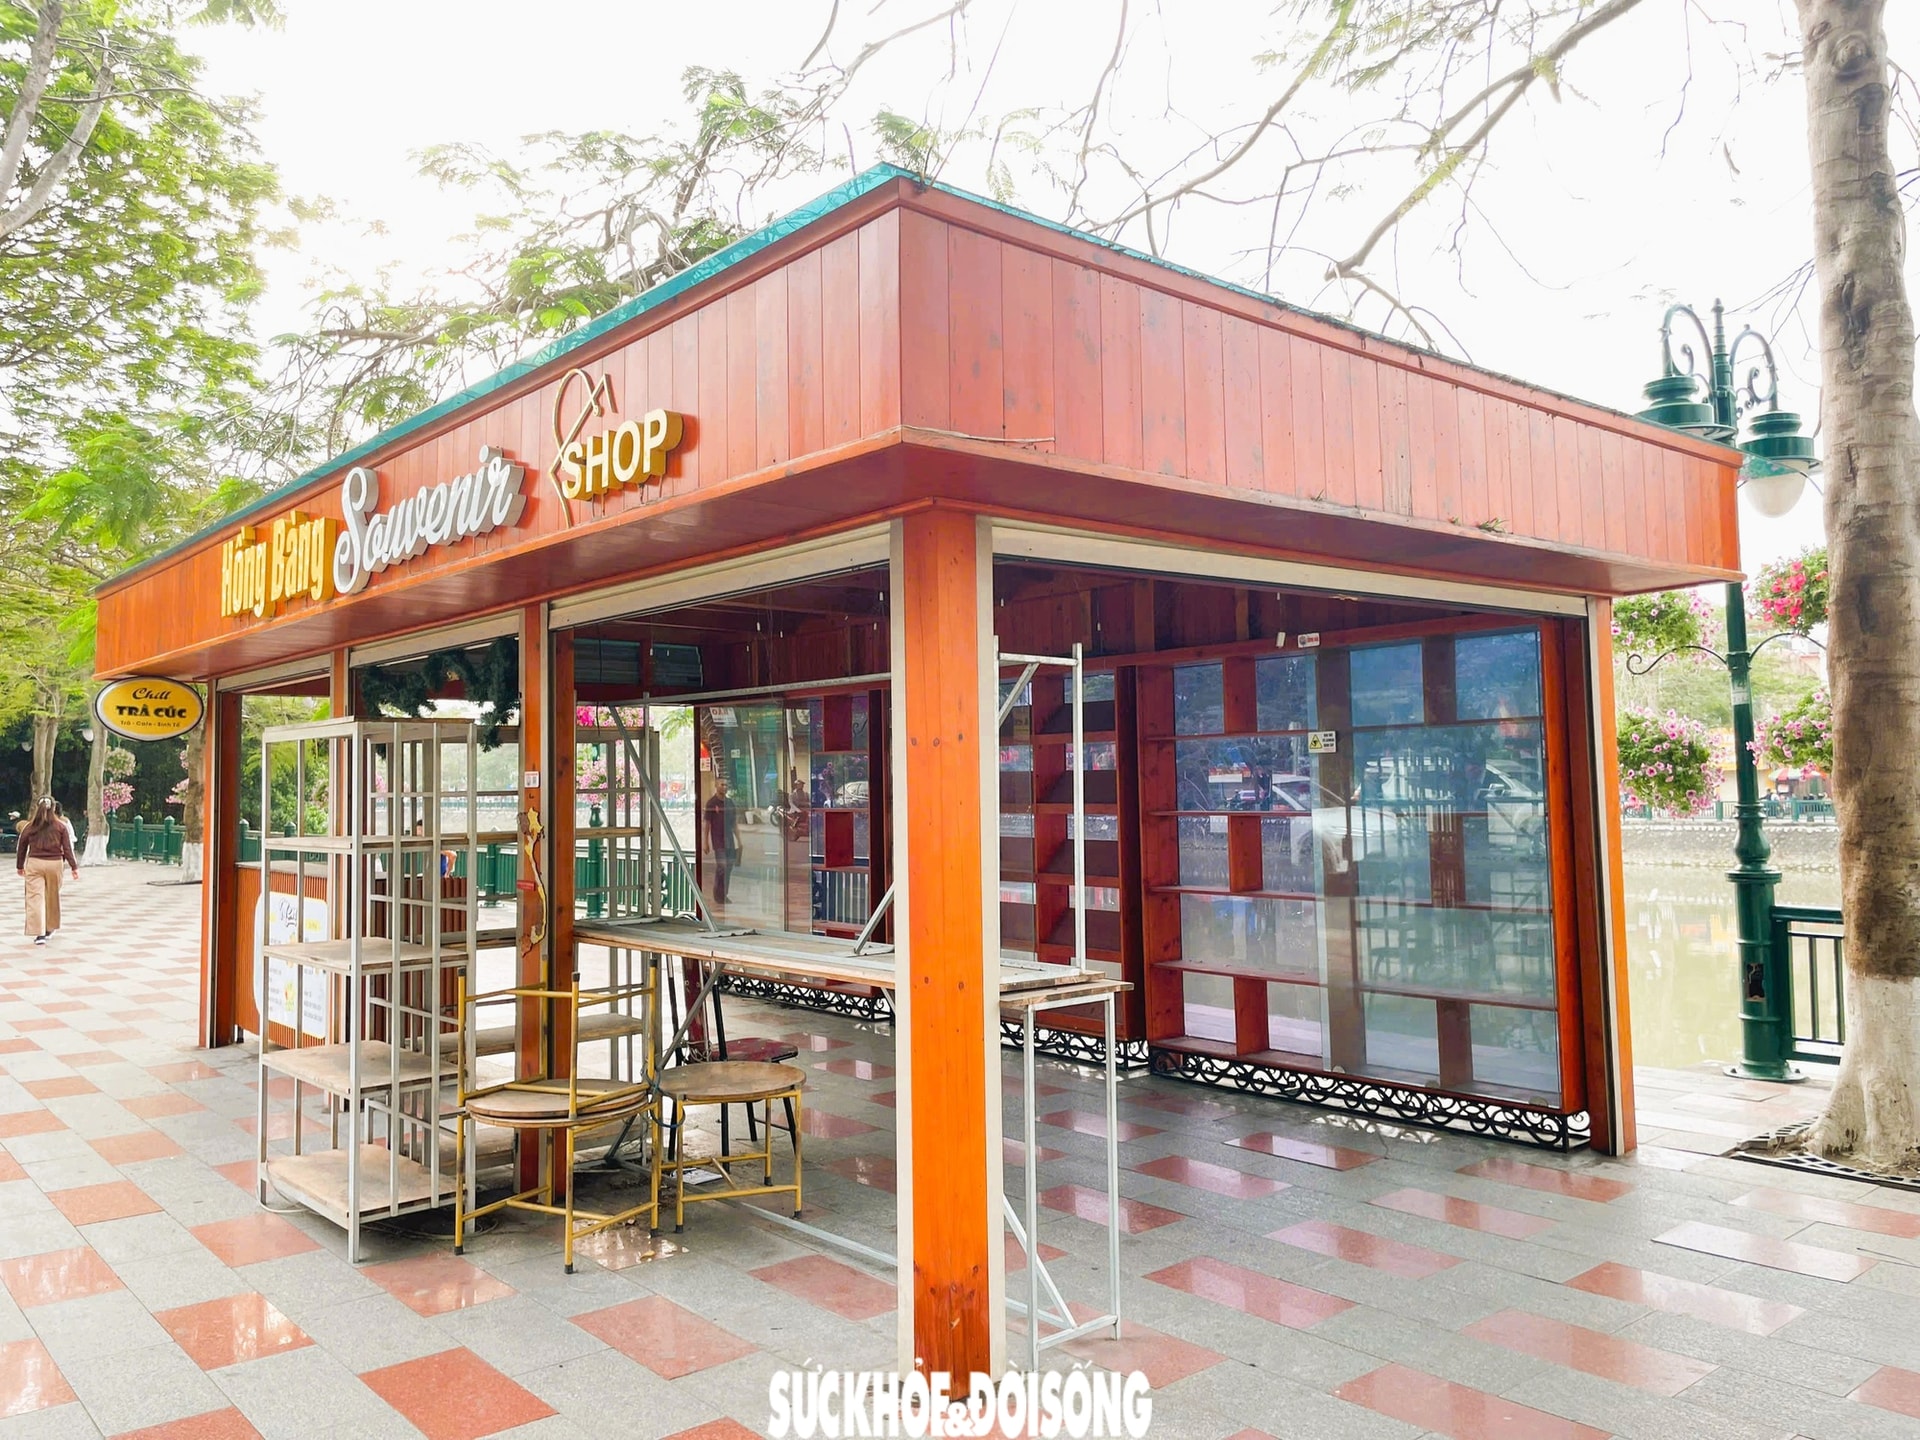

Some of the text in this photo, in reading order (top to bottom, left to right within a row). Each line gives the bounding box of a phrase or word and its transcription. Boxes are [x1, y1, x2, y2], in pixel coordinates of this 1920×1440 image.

[333, 444, 517, 594] Souvenir
[561, 408, 673, 499] SHOP
[132, 687, 171, 700] Chill
